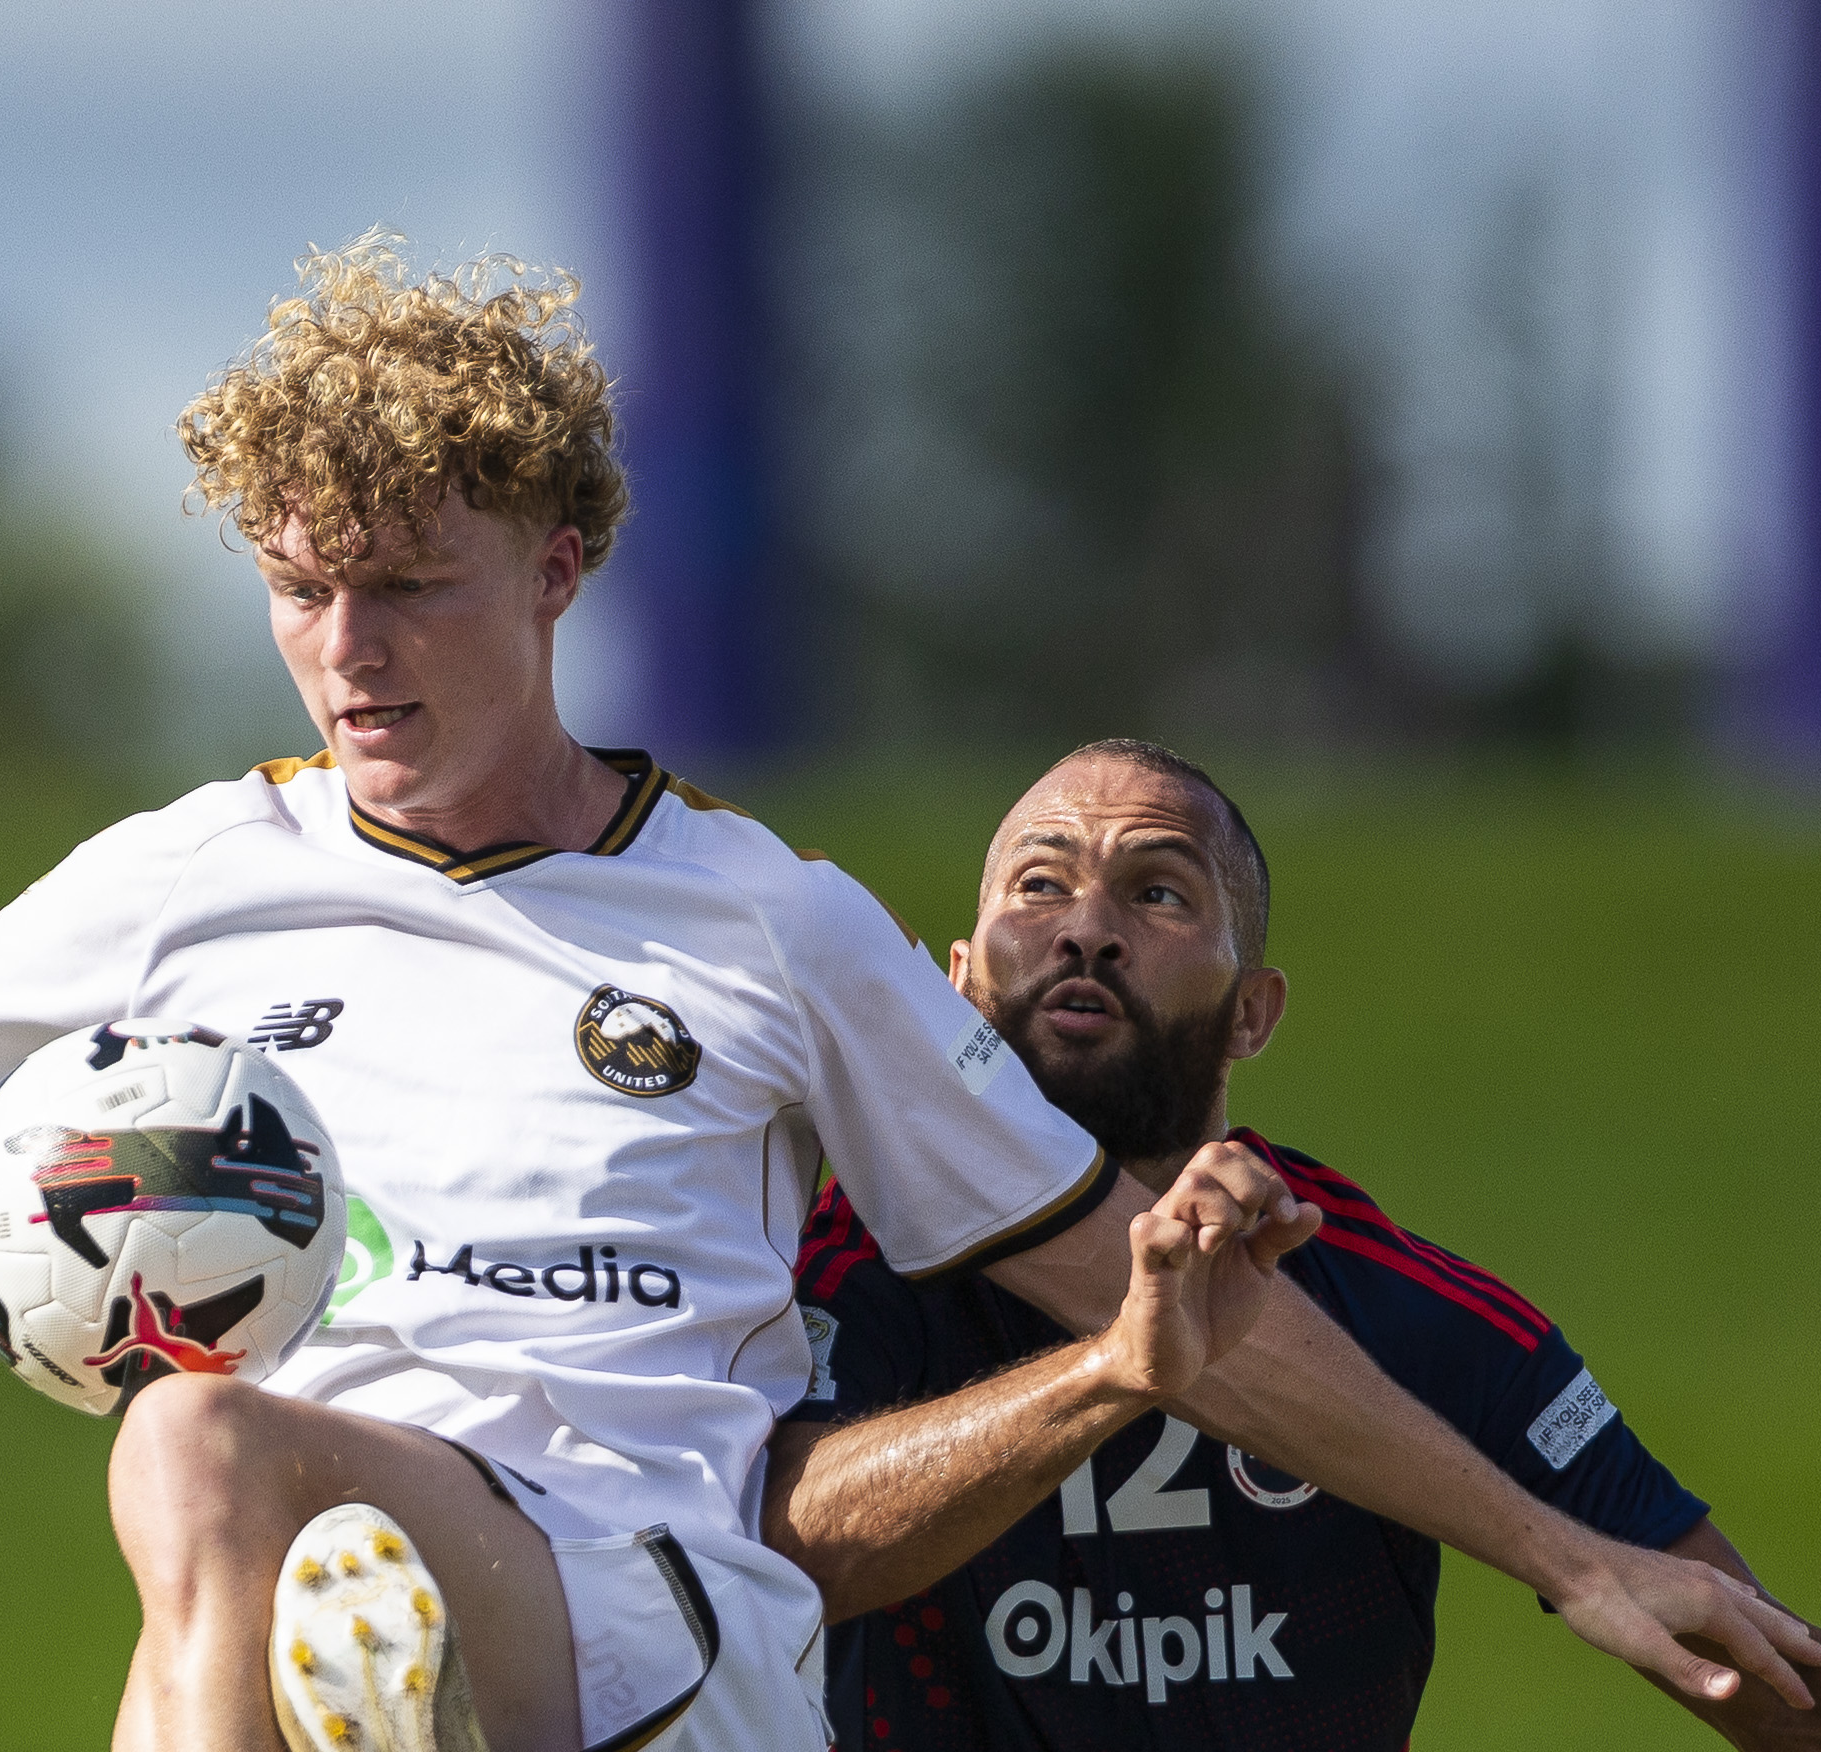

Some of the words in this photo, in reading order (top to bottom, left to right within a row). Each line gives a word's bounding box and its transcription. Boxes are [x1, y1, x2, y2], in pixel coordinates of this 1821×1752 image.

[602, 1064, 667, 1088] UNITED
[955, 1056, 965, 1070] IF
[961, 1039, 978, 1060] YOU
[977, 1043, 993, 1064] SAY
[407, 1240, 681, 1308] Media
[1539, 1426, 1553, 1445] IF
[1551, 1402, 1579, 1430] YOU
[1576, 1386, 1594, 1406] SEE
[1573, 1405, 1596, 1429] SAY
[1060, 1413, 1211, 1535] 12
[985, 1579, 1294, 1703] Okipik
